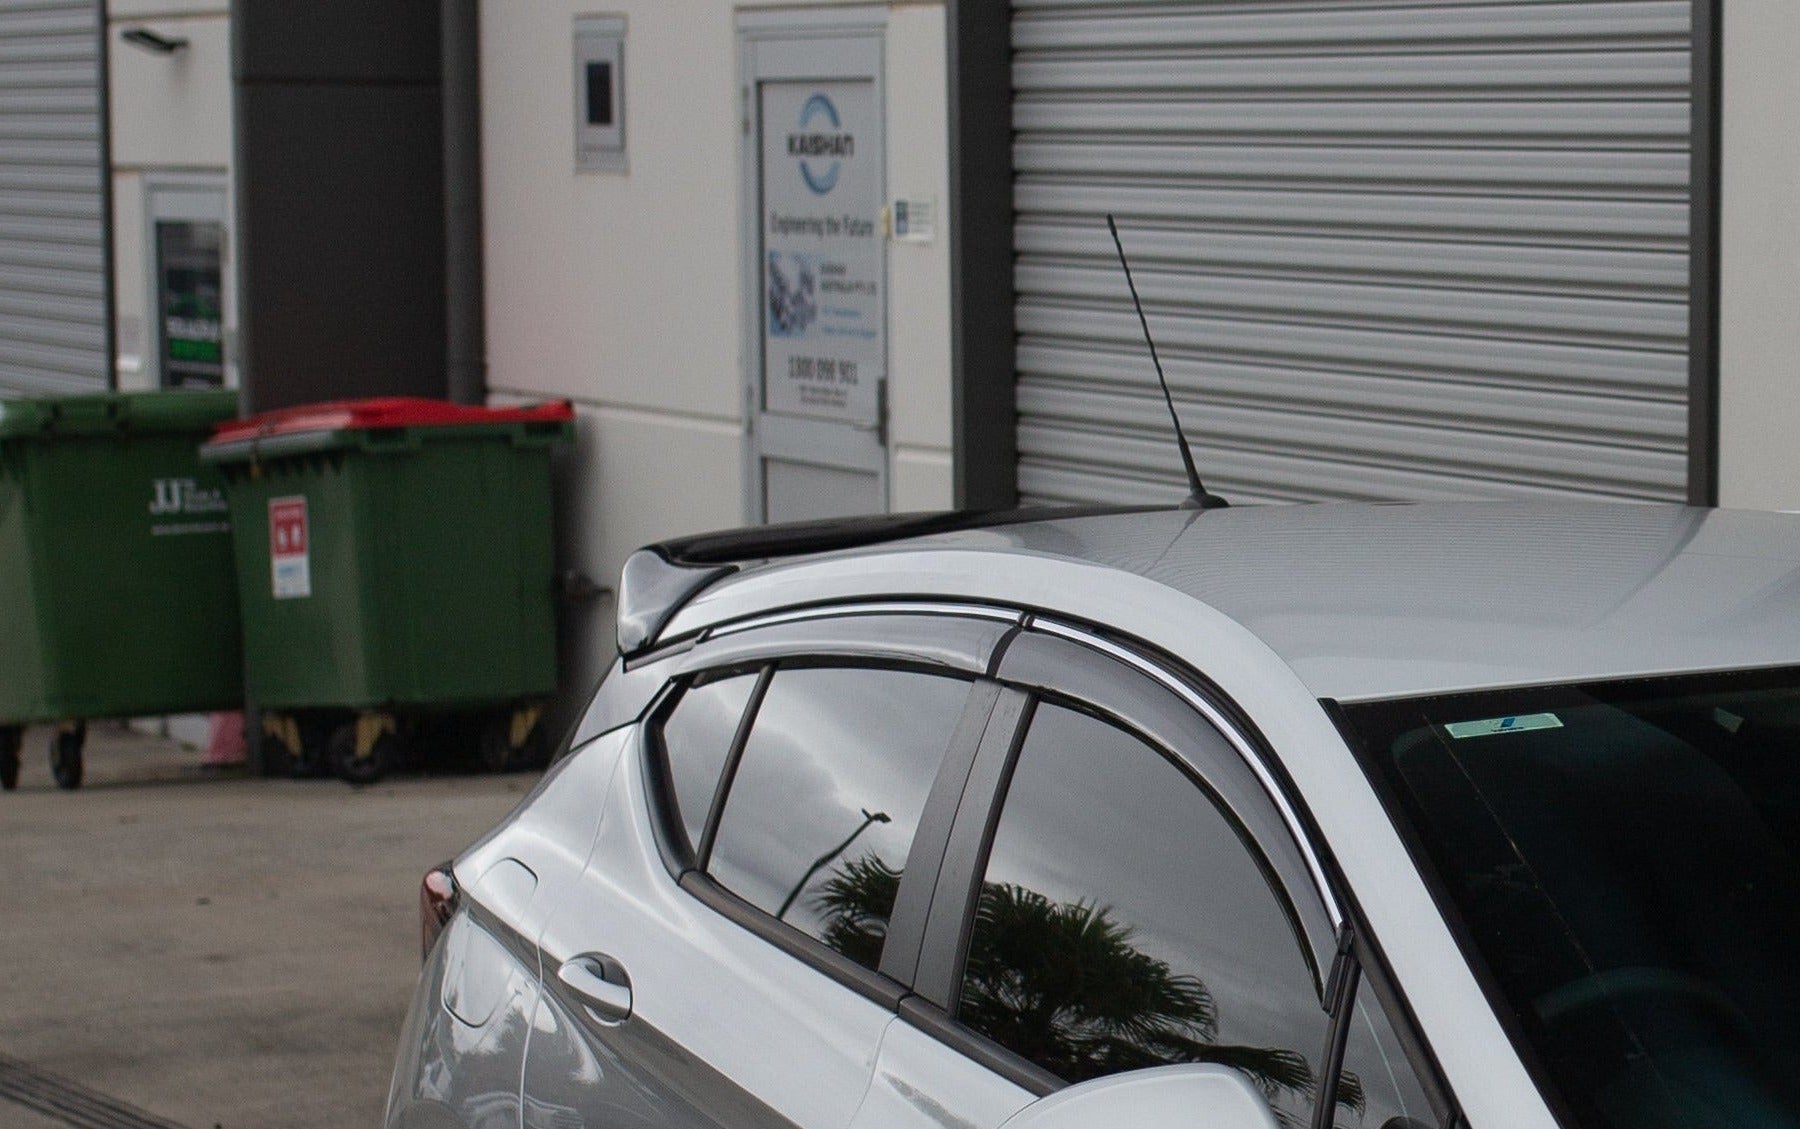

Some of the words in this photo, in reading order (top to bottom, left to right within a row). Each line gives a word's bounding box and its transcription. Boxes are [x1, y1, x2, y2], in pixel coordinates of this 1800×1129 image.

[787, 133, 855, 157] KAISHAN
[771, 211, 824, 238] Engineering
[826, 216, 840, 234] the
[843, 214, 874, 237] Future
